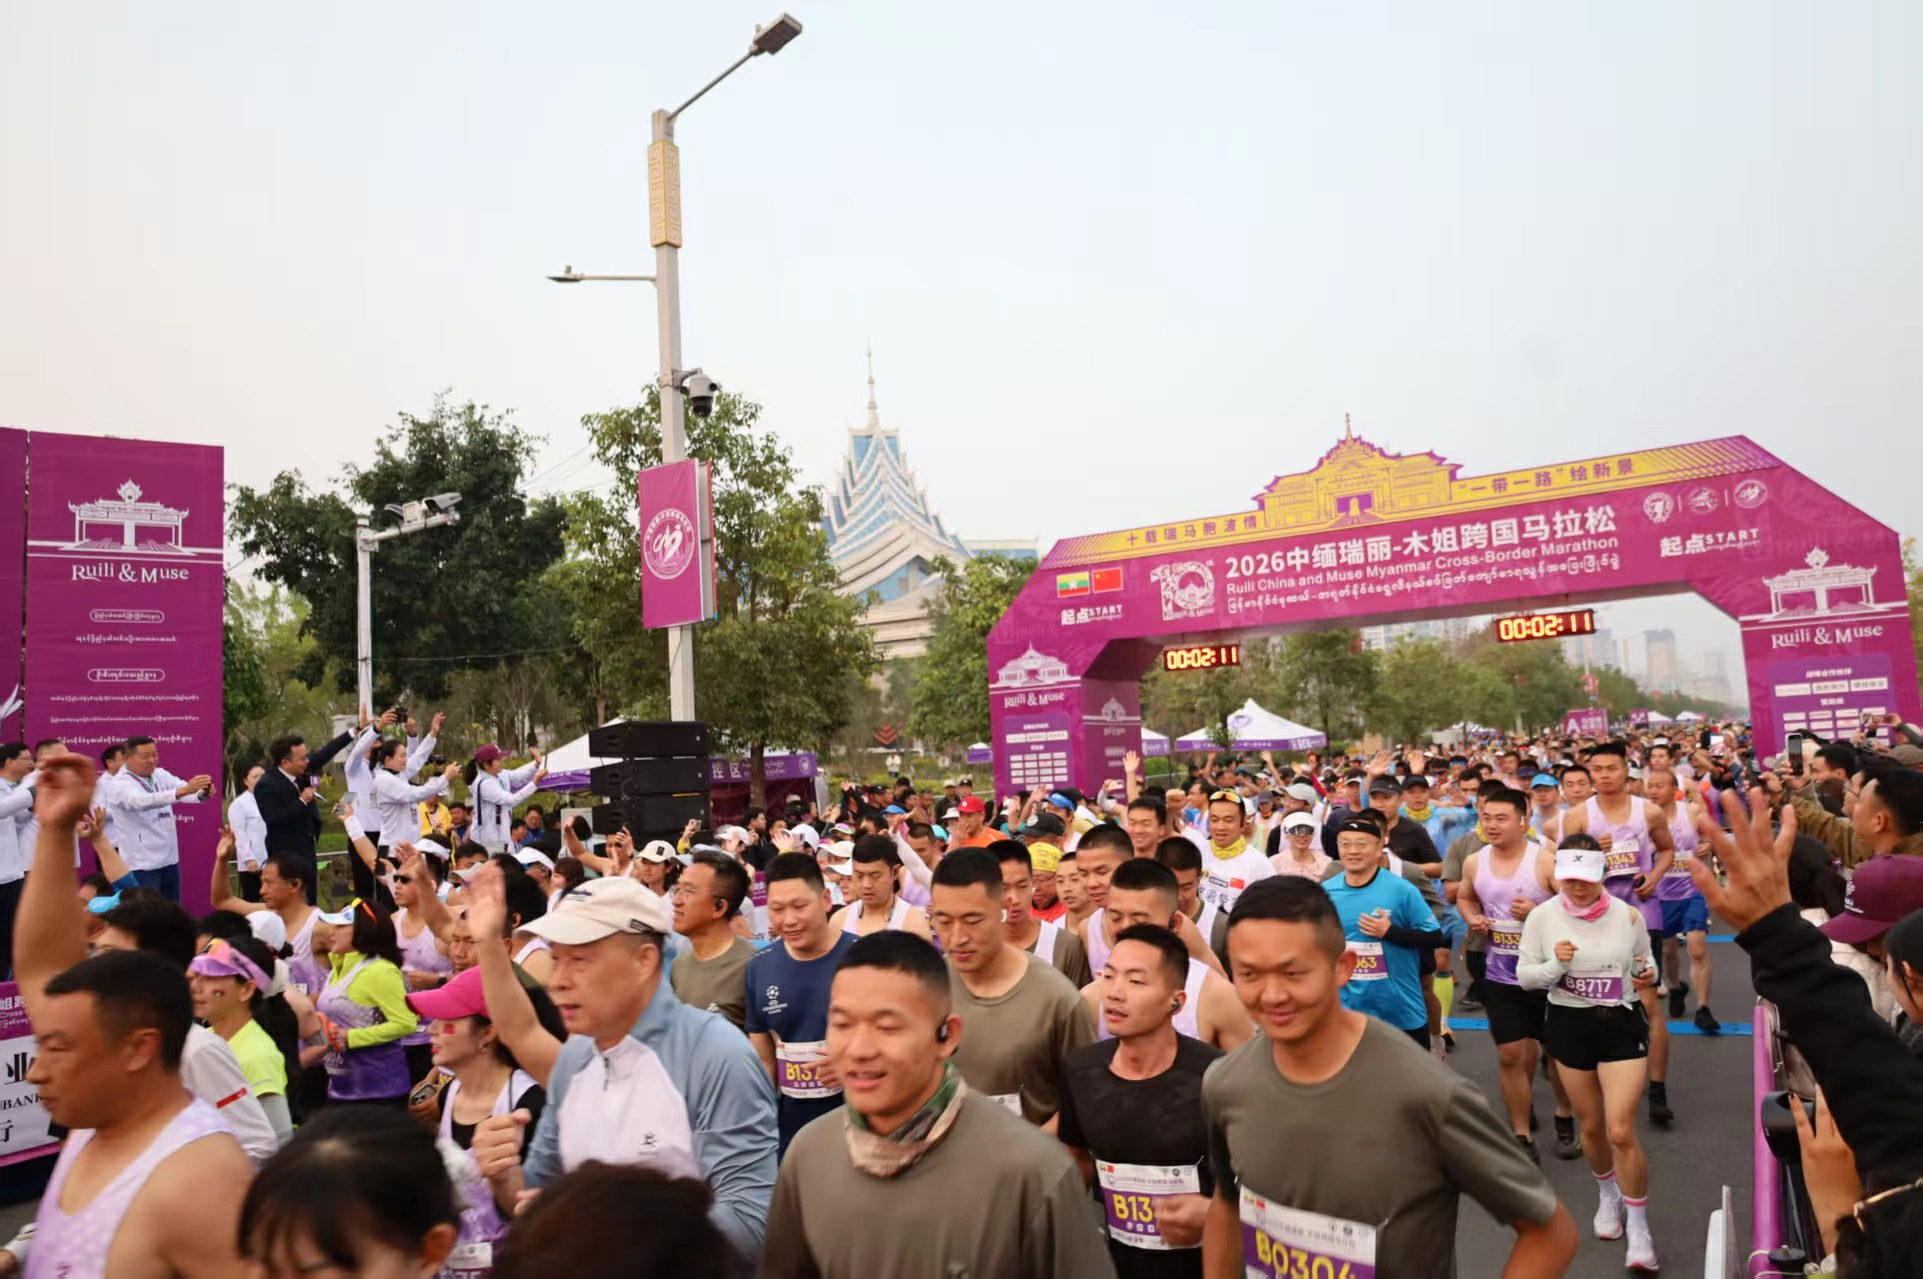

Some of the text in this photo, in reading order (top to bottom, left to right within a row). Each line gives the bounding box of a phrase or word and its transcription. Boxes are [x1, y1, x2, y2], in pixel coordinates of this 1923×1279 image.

[1225, 504, 1617, 579] 2026中缅瑞丽-木姐跨国马拉松
[1660, 534, 1706, 557] 起点
[1705, 528, 1759, 545] START
[71, 562, 190, 583] Ruili & Muse
[1226, 536, 1618, 594] Ruili China and Muse Myanmar Cross-Border Marathon
[1061, 607, 1090, 626] 起点
[1088, 604, 1123, 617] START
[1499, 612, 1591, 641] 00:02:11
[1771, 625, 1883, 649] Ruili & Muse
[1166, 646, 1237, 670] 00:02:11
[1004, 692, 1065, 708] Ruili & Muse
[1565, 976, 1612, 993] B8717
[1113, 1193, 1154, 1223] B13
